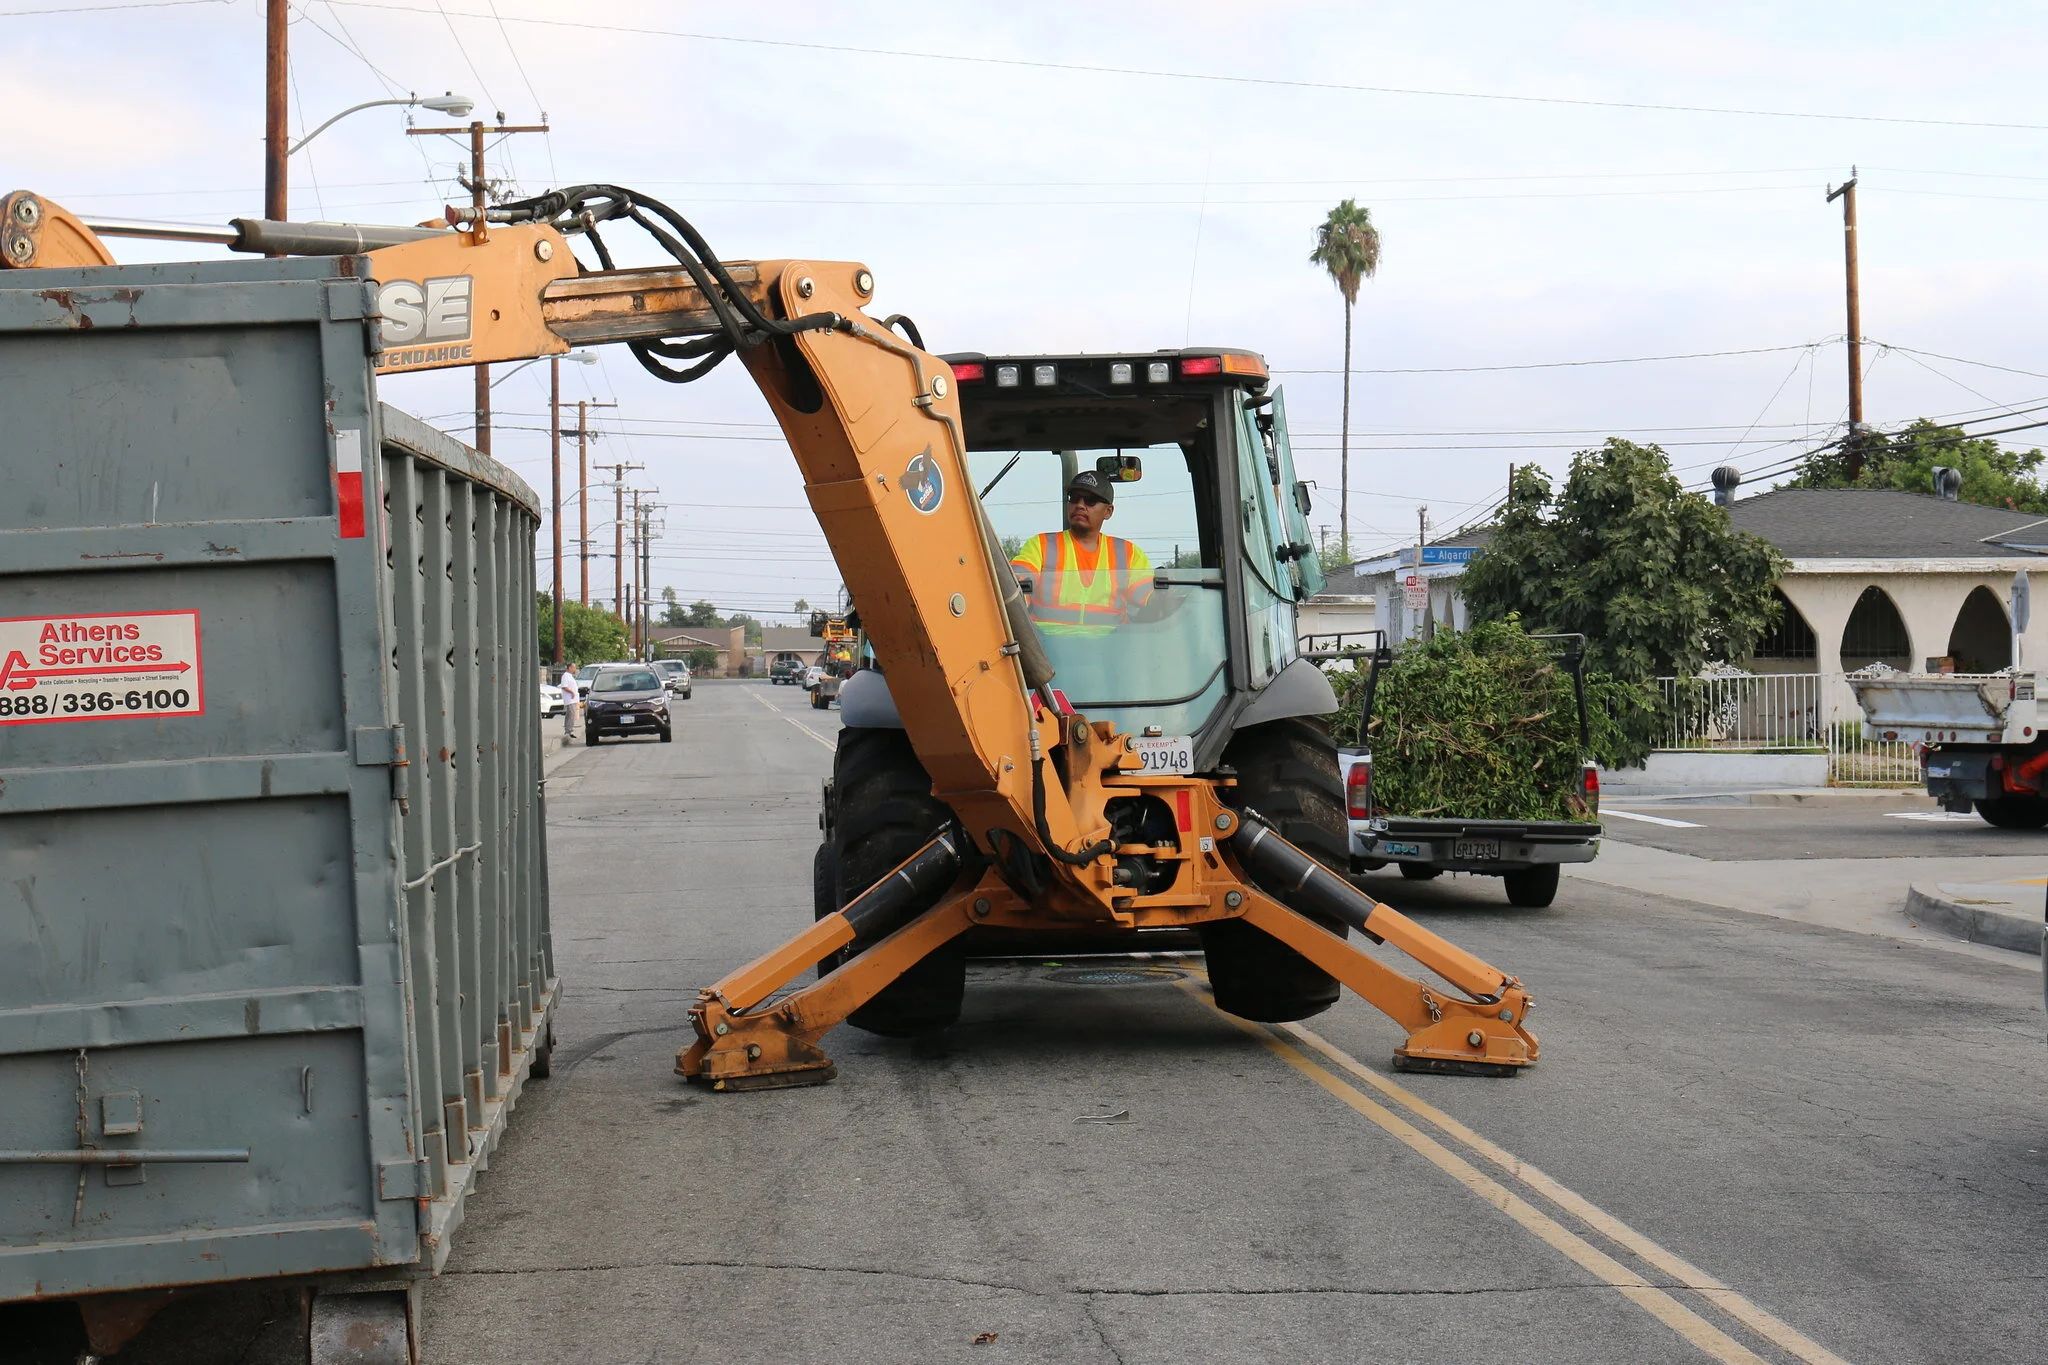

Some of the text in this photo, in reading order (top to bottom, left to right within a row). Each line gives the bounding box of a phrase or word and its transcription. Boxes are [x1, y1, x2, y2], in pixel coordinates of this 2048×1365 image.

[1438, 550, 1471, 563] Algardi
[1407, 586, 1427, 594] PARKING
[39, 621, 140, 644] Athens
[39, 642, 163, 666] Services
[53, 678, 74, 686] Collection
[78, 677, 98, 685] Recycling
[124, 675, 141, 683] Disposal
[159, 674, 179, 682] Sweeping
[0, 688, 190, 716] 888/336-6100
[1141, 750, 1188, 770] 91948
